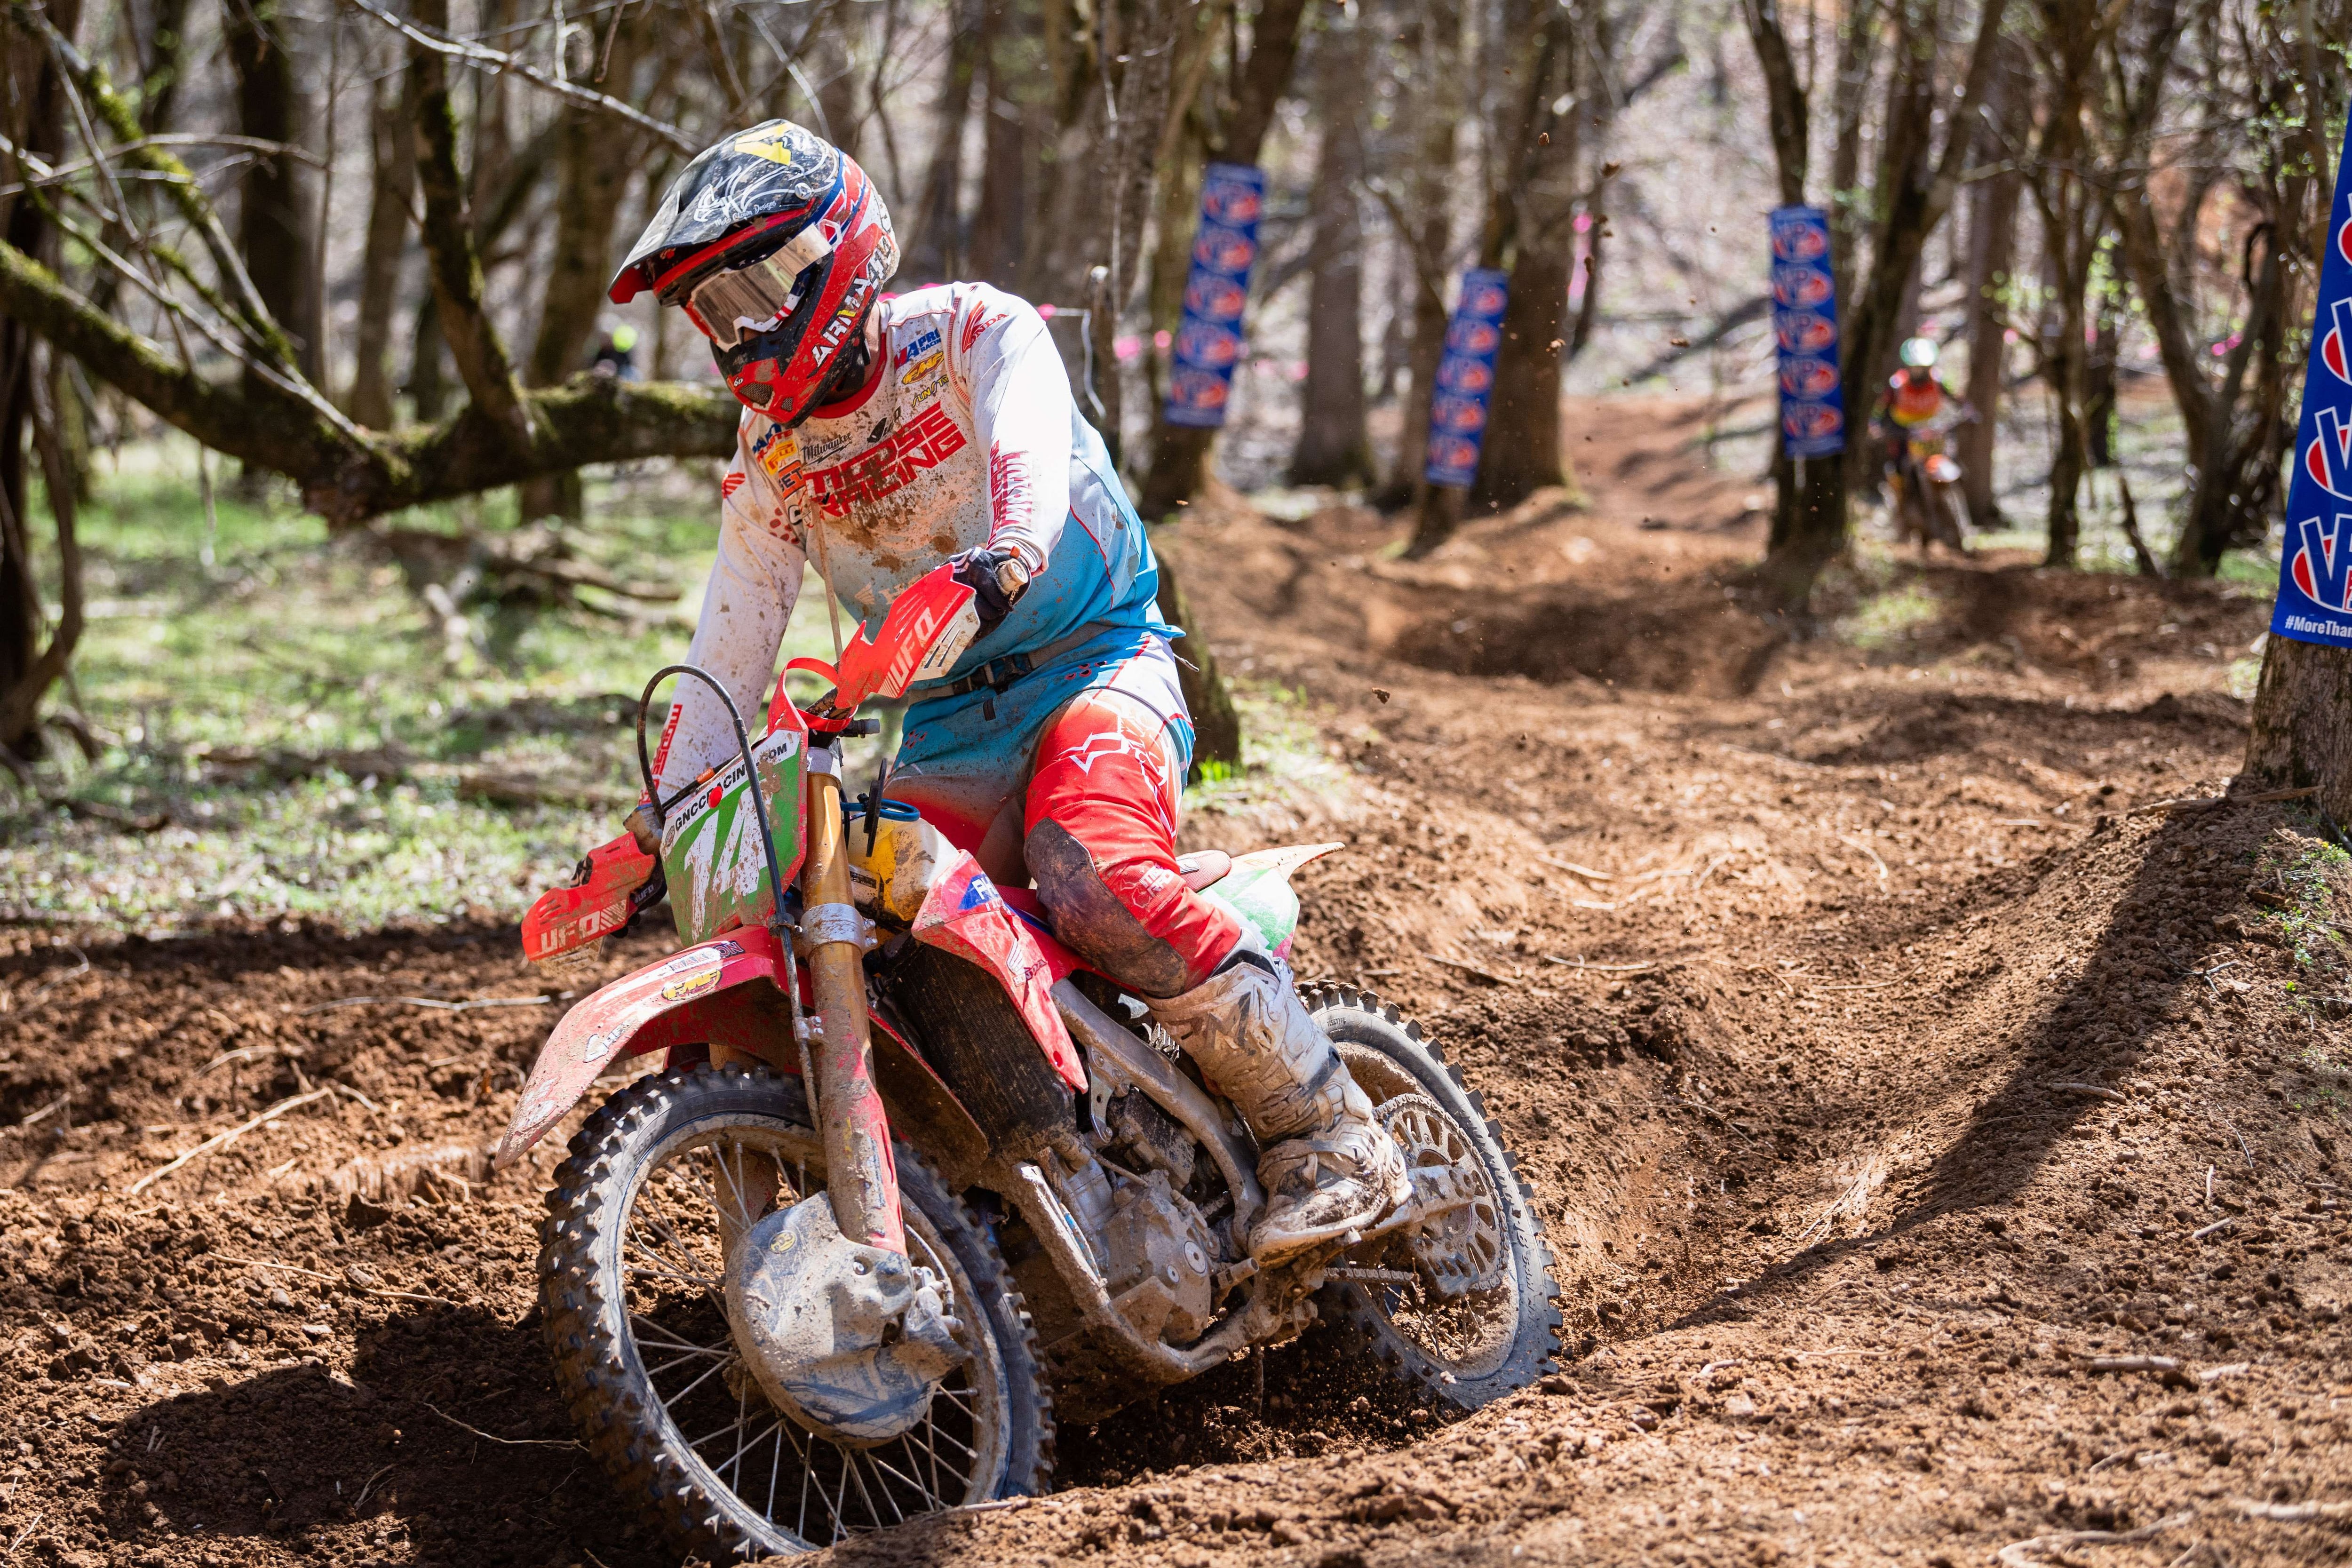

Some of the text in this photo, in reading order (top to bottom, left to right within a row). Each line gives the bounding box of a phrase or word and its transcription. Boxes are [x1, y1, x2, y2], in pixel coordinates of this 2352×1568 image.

[753, 200, 777, 214] Designs
[801, 432, 852, 460] Milwaukee
[890, 606, 938, 688] UFO
[541, 910, 600, 953] UFO
